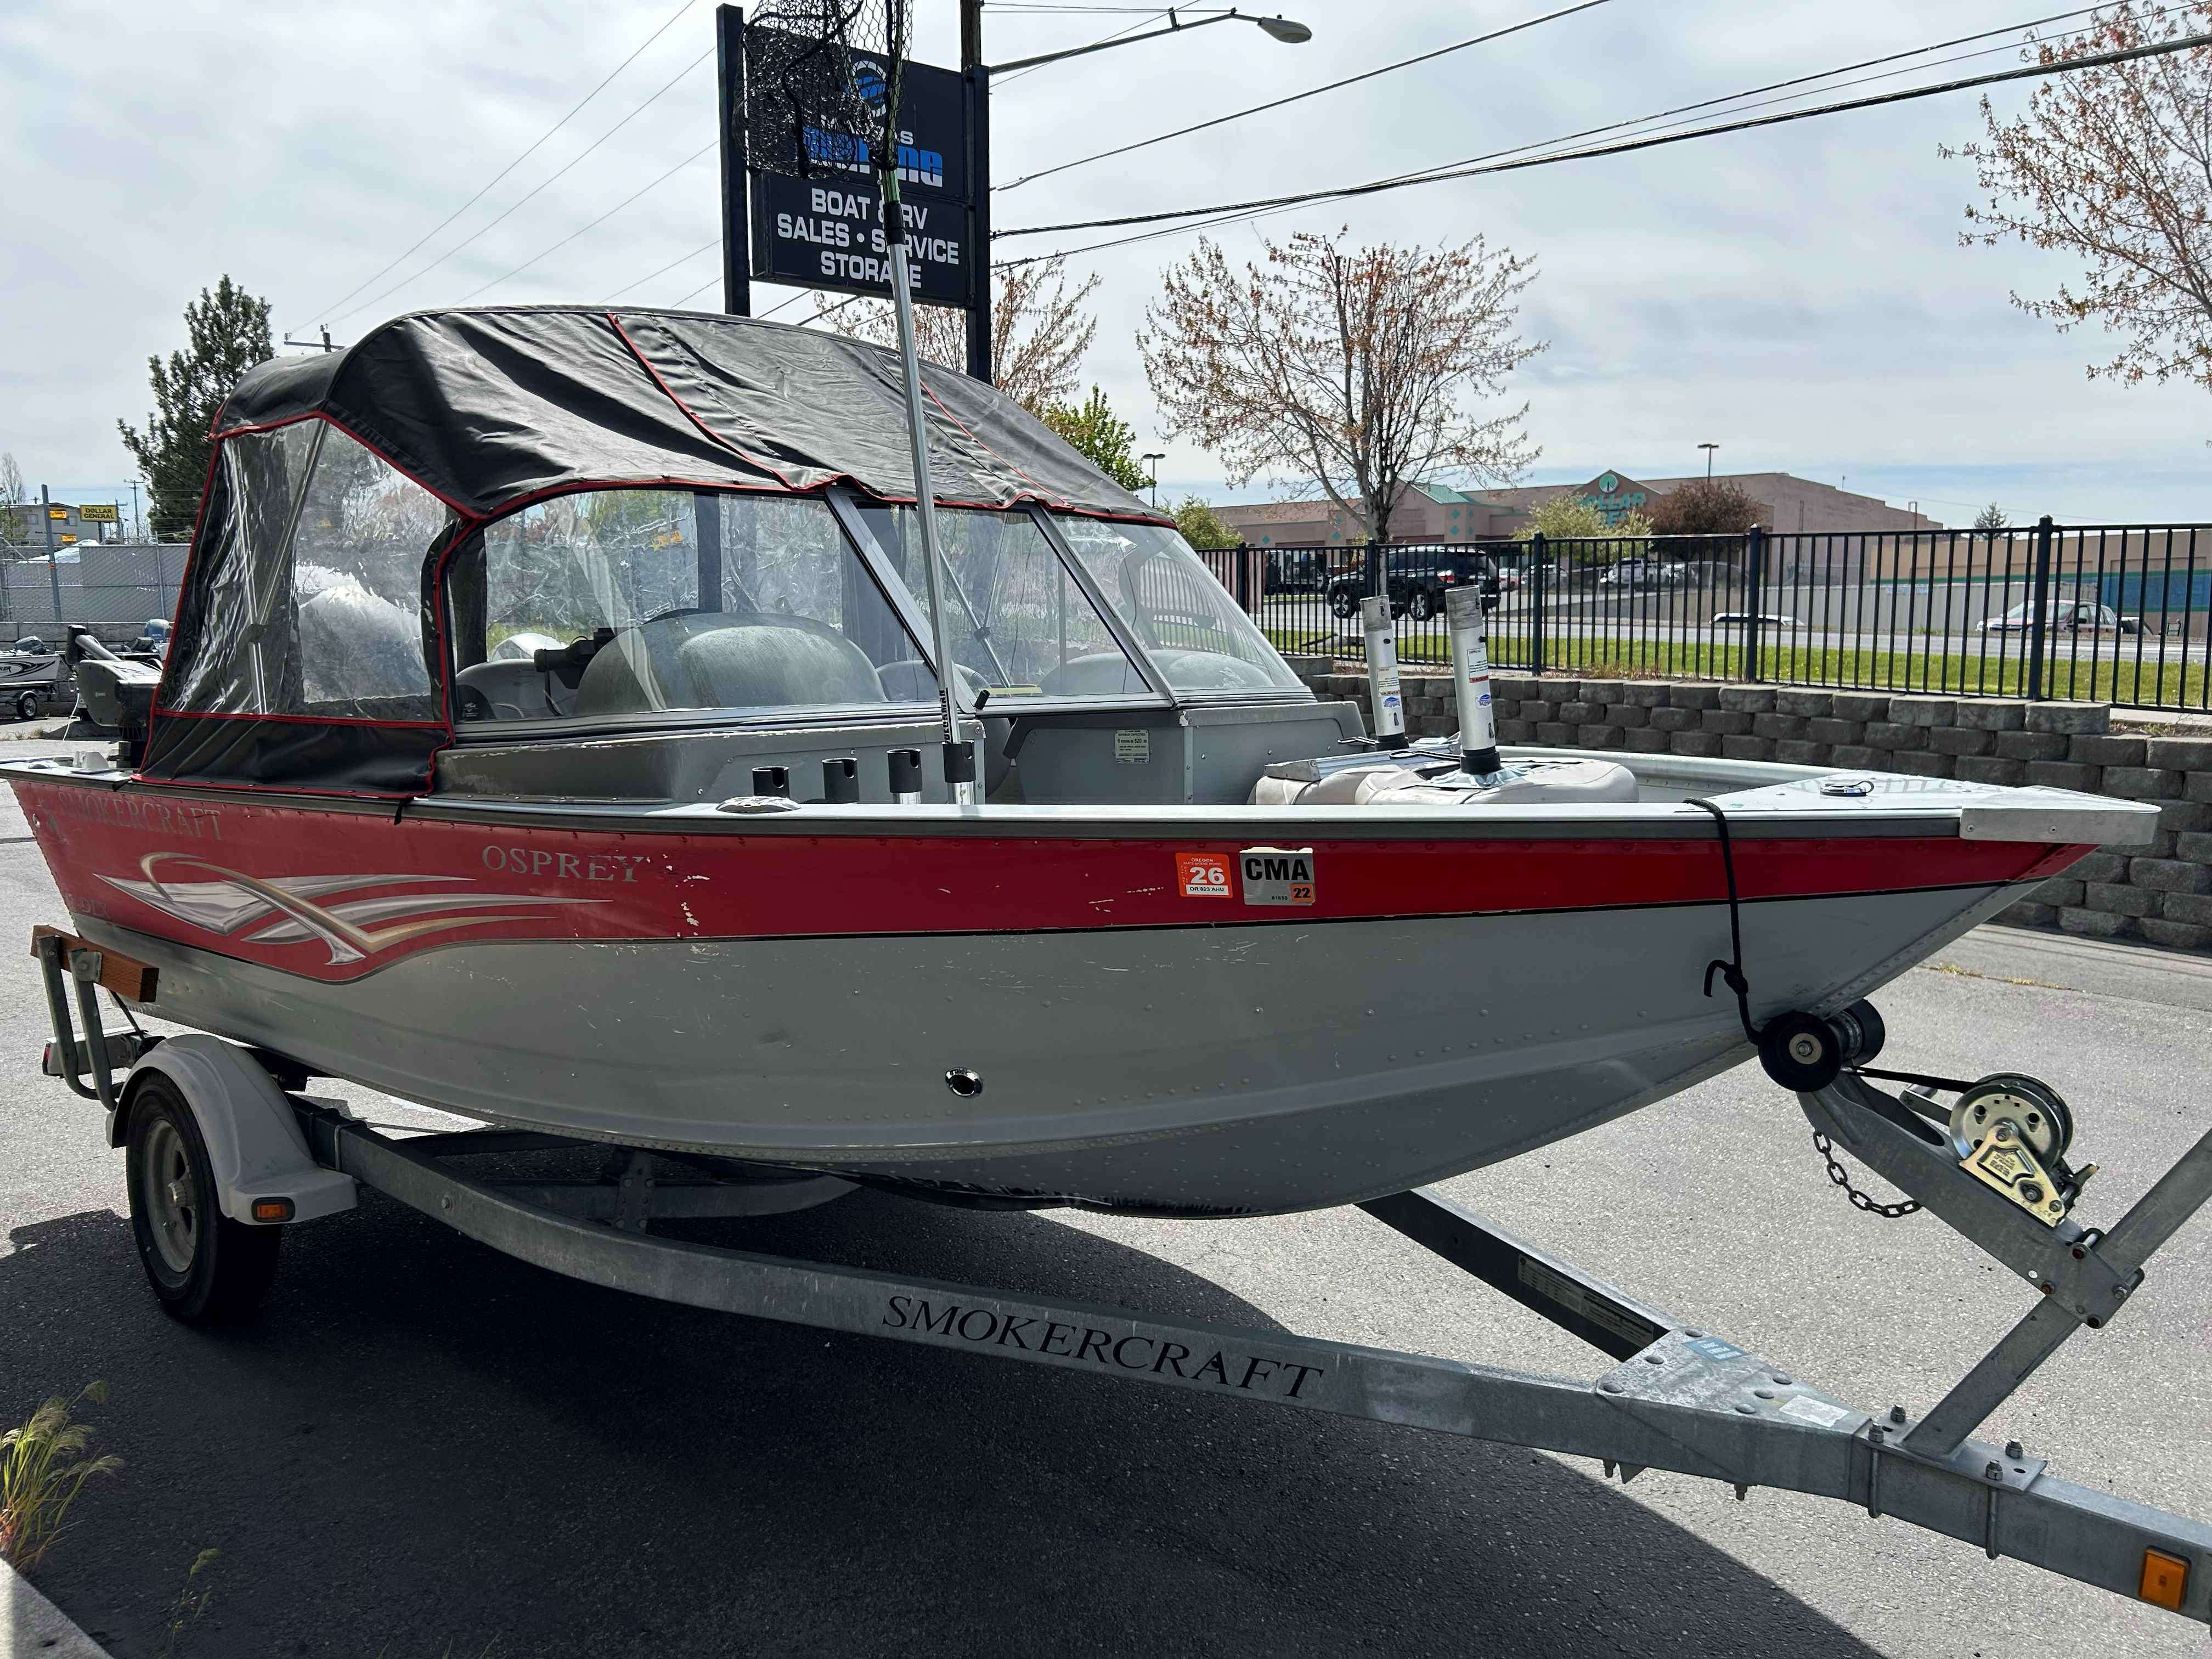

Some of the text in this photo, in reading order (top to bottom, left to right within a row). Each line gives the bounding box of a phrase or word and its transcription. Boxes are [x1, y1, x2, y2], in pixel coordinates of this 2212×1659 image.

[811, 188, 871, 220] BOAT
[901, 204, 928, 230] RV
[777, 213, 959, 265] SALES SRVICE
[821, 251, 922, 289] STORAE
[482, 845, 645, 882] OSPREY
[1189, 866, 1225, 885] 26
[1245, 858, 1310, 881] CMA
[1294, 887, 1311, 899] 22
[882, 1295, 1324, 1400] SMOKERCRAFT
